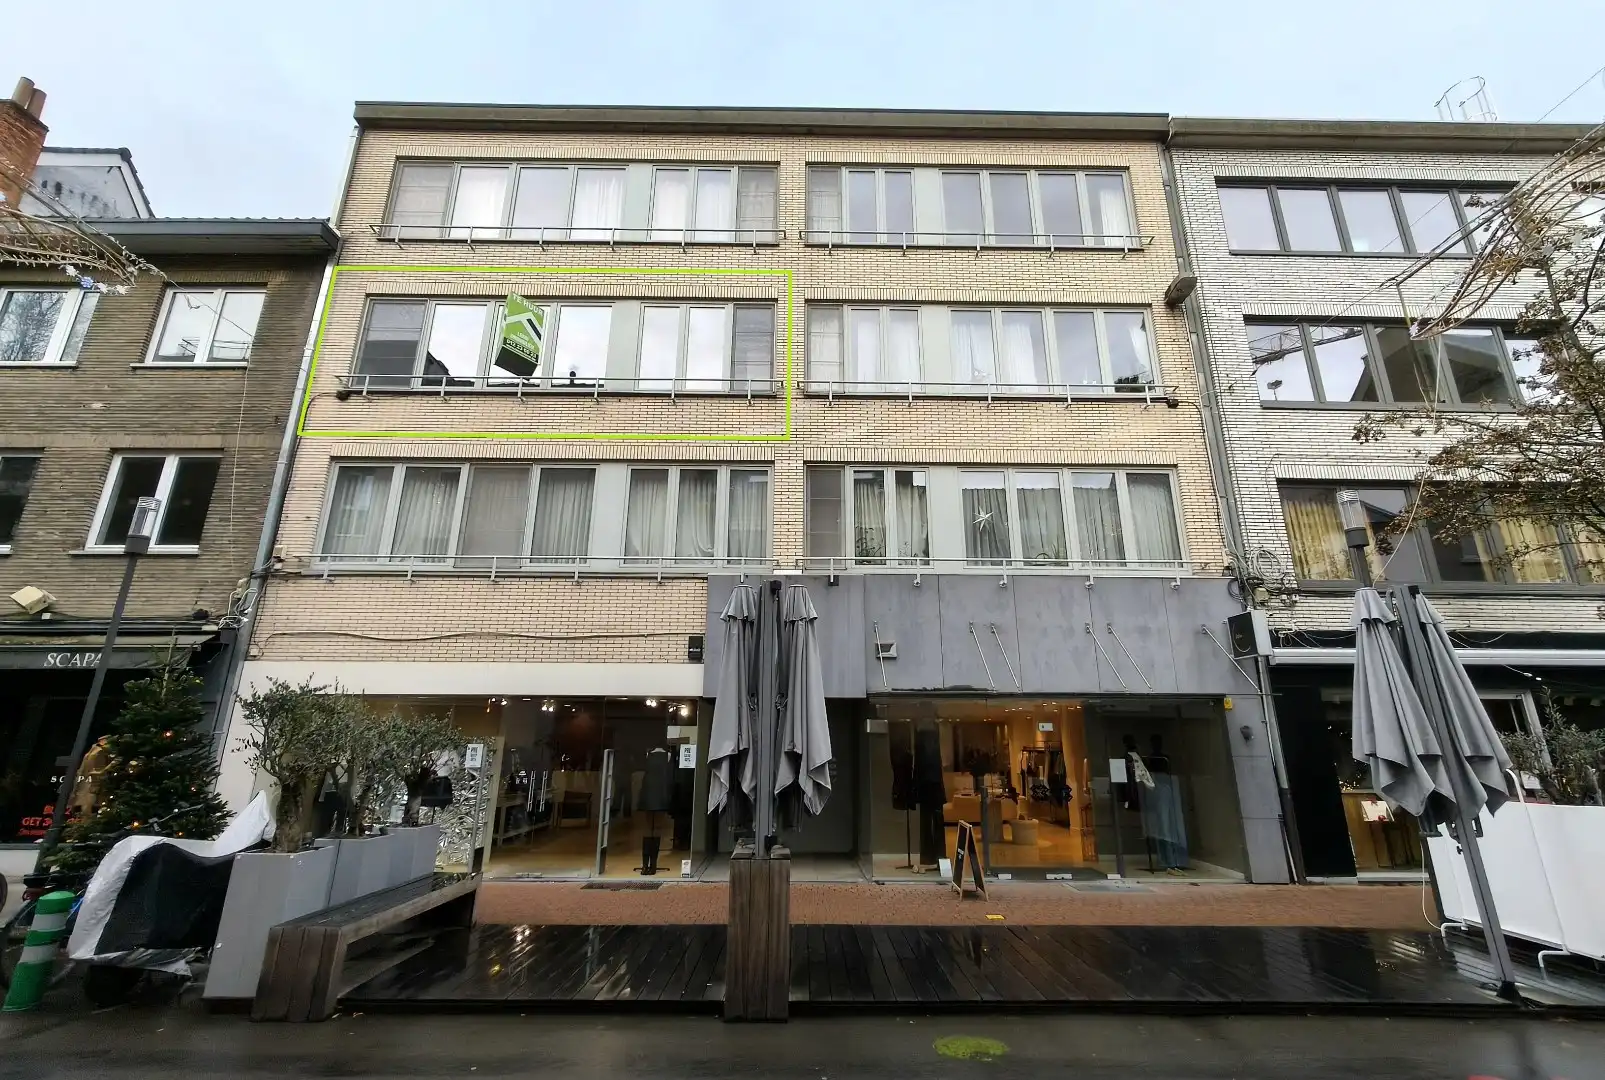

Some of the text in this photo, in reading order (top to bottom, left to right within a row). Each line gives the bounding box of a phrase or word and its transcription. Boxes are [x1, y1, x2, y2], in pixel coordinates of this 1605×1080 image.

[512, 293, 544, 316] TE HUUR
[43, 652, 103, 668] SCAPA
[50, 775, 93, 783] SCPA
[22, 817, 42, 826] GET
